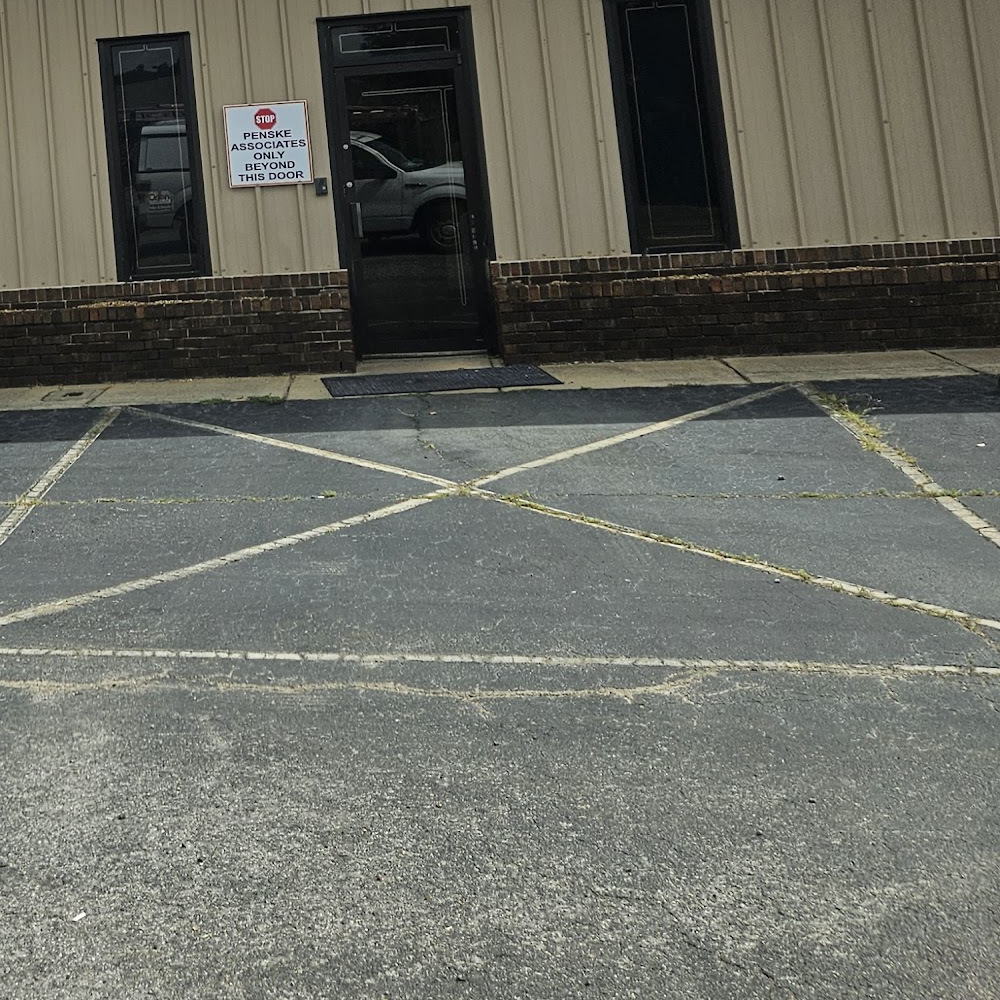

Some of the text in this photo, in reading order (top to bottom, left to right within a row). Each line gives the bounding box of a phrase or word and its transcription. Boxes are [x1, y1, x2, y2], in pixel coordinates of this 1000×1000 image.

[255, 114, 276, 124] STOP
[243, 129, 292, 140] PENSKE
[230, 139, 307, 152] ASSOCIATES
[253, 151, 286, 160] ONLY
[245, 160, 295, 171] BEYOND
[238, 170, 305, 182] THIS DOOR
